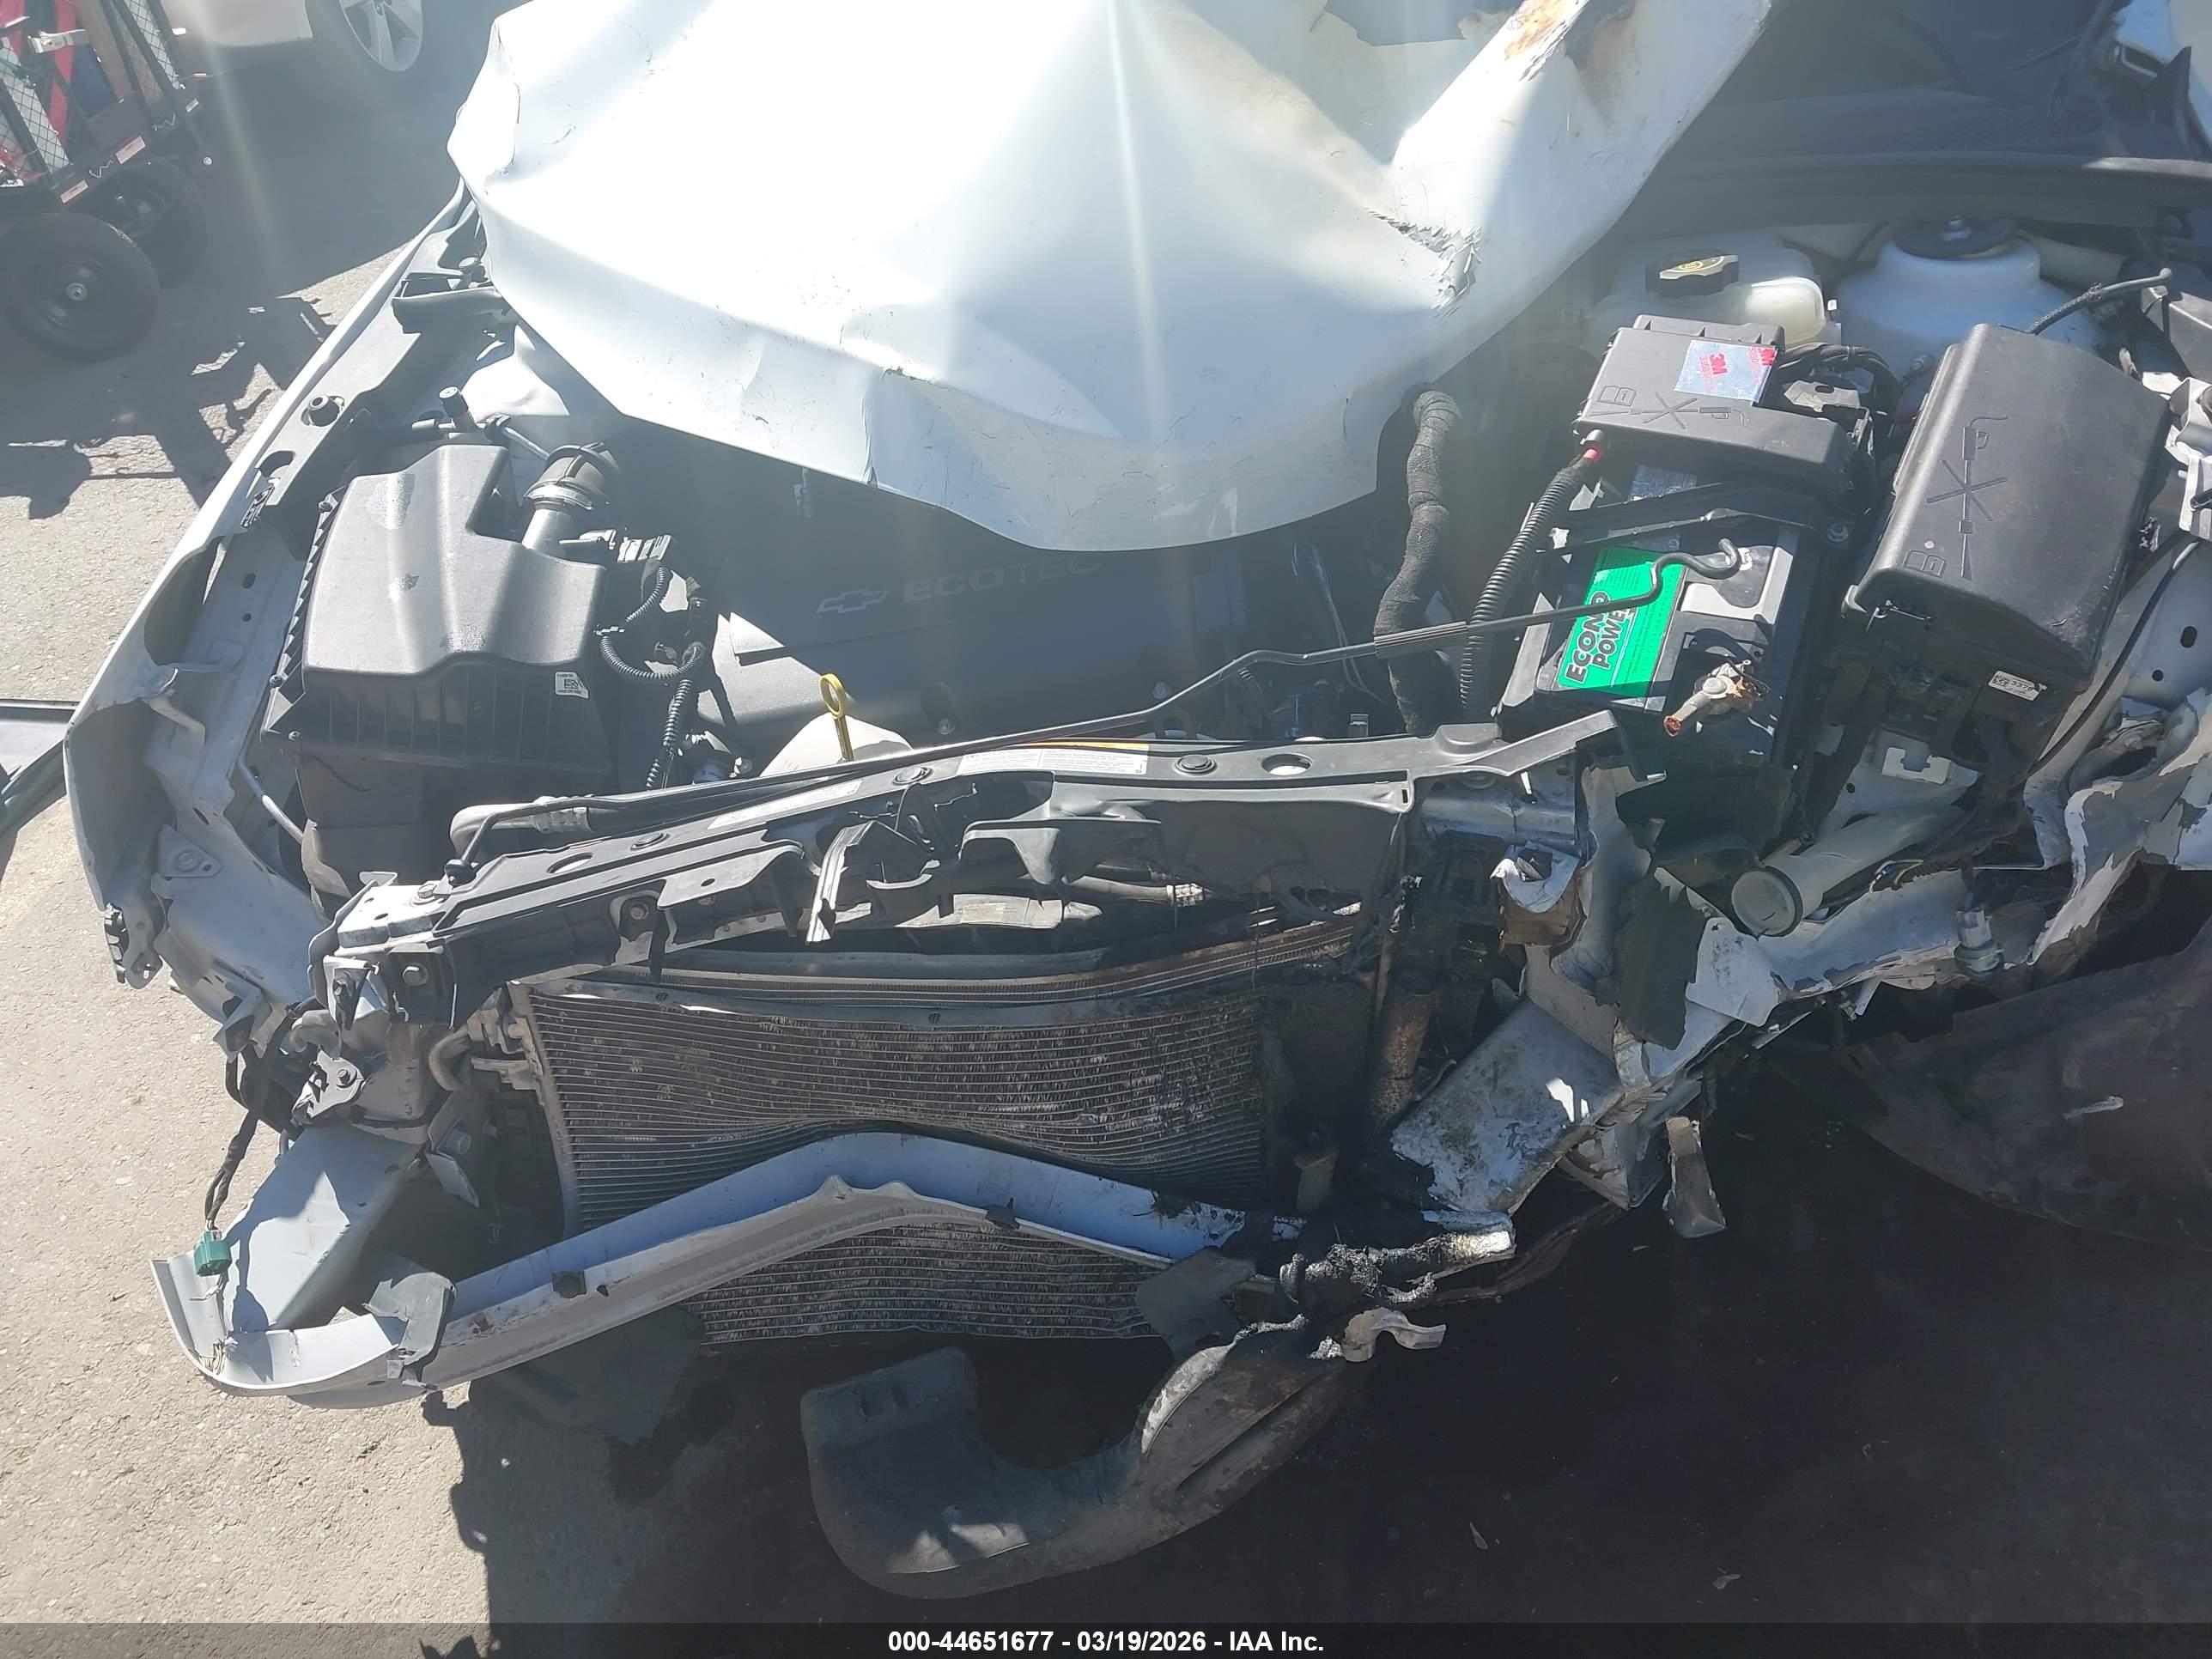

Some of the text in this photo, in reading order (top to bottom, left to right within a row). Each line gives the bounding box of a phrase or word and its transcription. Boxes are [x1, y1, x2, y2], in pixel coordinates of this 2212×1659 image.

[1709, 353, 1728, 374] 3M
[903, 555, 1103, 603] ECOTEC
[1591, 607, 1628, 670] POWE
